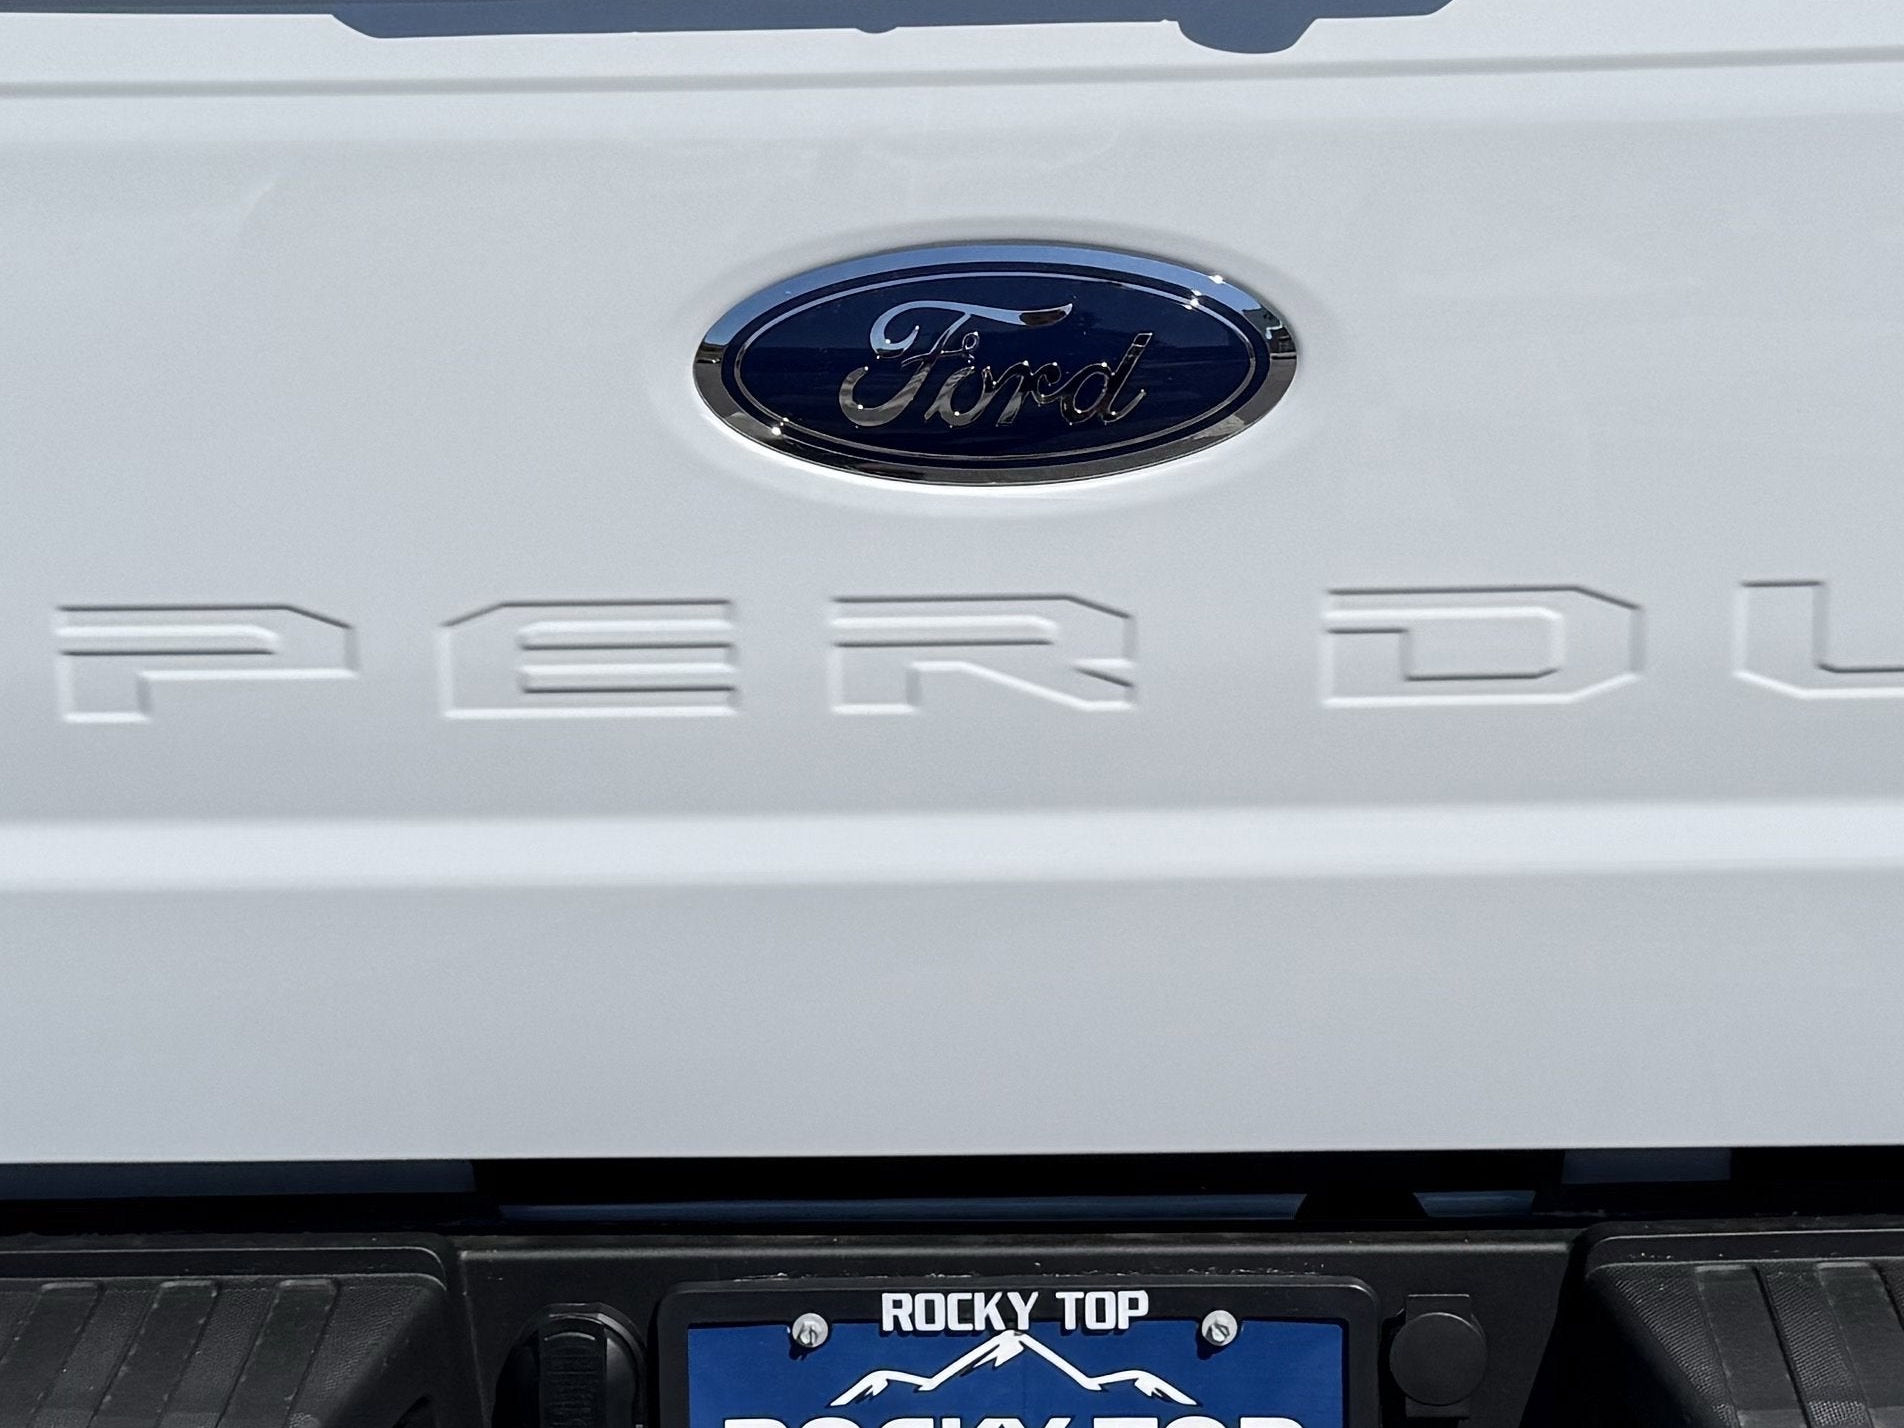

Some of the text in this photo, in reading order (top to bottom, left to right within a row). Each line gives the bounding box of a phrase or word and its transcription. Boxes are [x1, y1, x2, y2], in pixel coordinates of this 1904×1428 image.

[838, 299, 1155, 429] Ford
[880, 1289, 1150, 1333] ROCKY TOP
